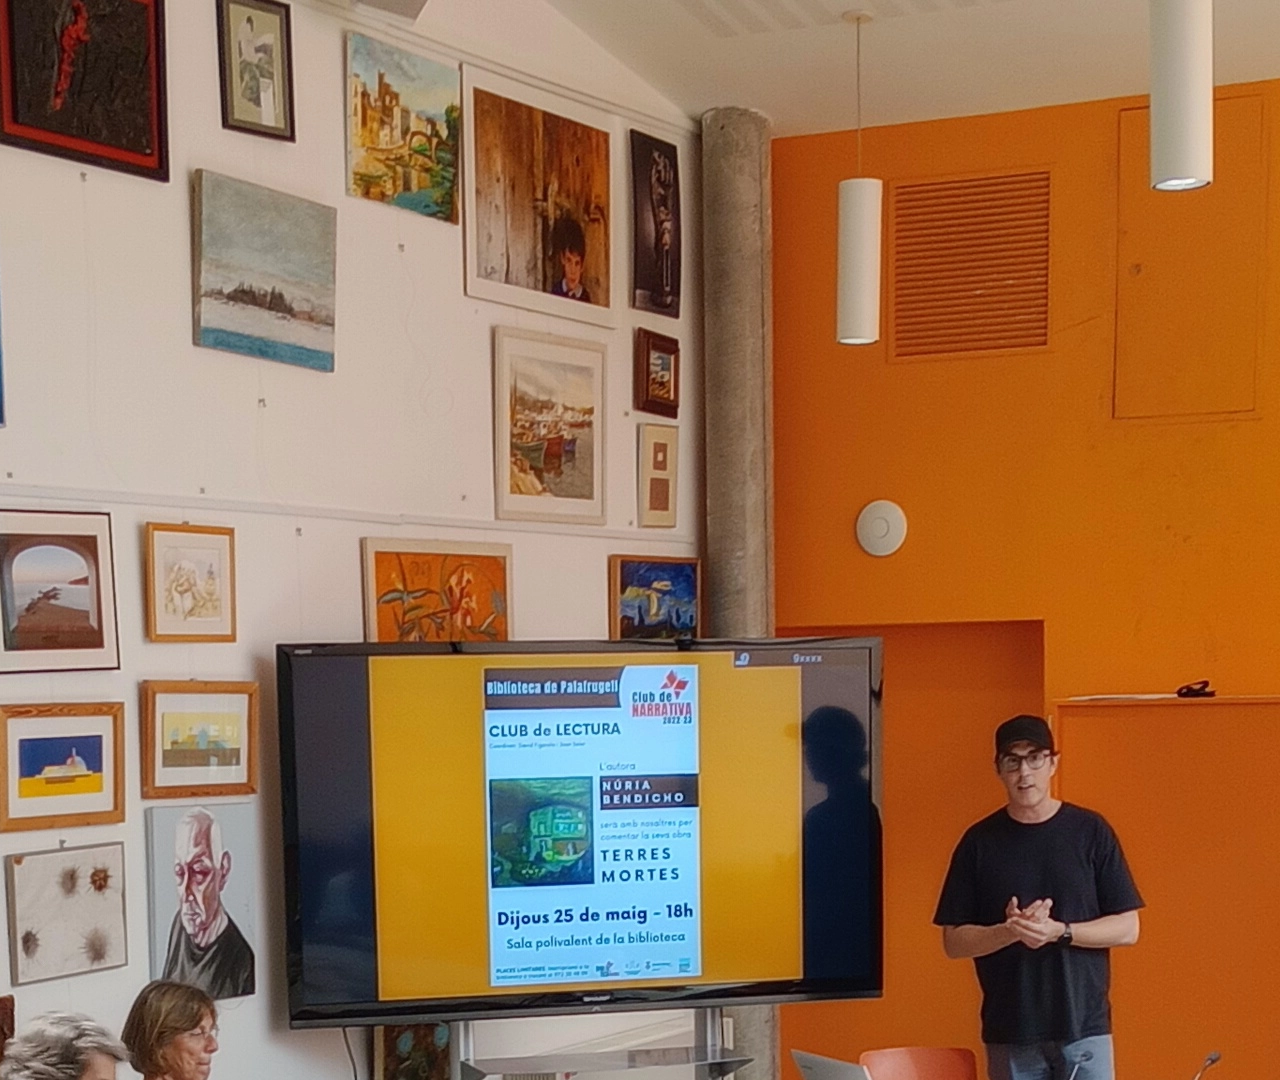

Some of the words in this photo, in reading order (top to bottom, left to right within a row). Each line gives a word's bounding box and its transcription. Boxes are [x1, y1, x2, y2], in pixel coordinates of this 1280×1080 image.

[486, 681, 541, 695] Biblioteca
[544, 680, 557, 694] de
[560, 679, 619, 694] Palafrugell
[632, 691, 655, 703] Club
[659, 691, 672, 703] de
[632, 702, 692, 717] NARRATIVA
[489, 724, 529, 738] CLUB
[533, 723, 551, 736] de
[556, 722, 621, 736] LECTURA
[602, 778, 651, 791] NÚRIA
[602, 791, 685, 804] BENDICHO
[601, 848, 671, 862] TERRES
[601, 867, 679, 883] MORTES
[497, 910, 550, 930] Dijous
[553, 908, 574, 924] 25
[579, 905, 600, 922] de
[605, 905, 648, 925] maig
[665, 903, 694, 919] 18h
[506, 937, 533, 950] Sala
[535, 933, 593, 951] polivalent
[595, 932, 610, 946] de
[613, 932, 625, 945] la
[627, 930, 686, 944] biblioteca
